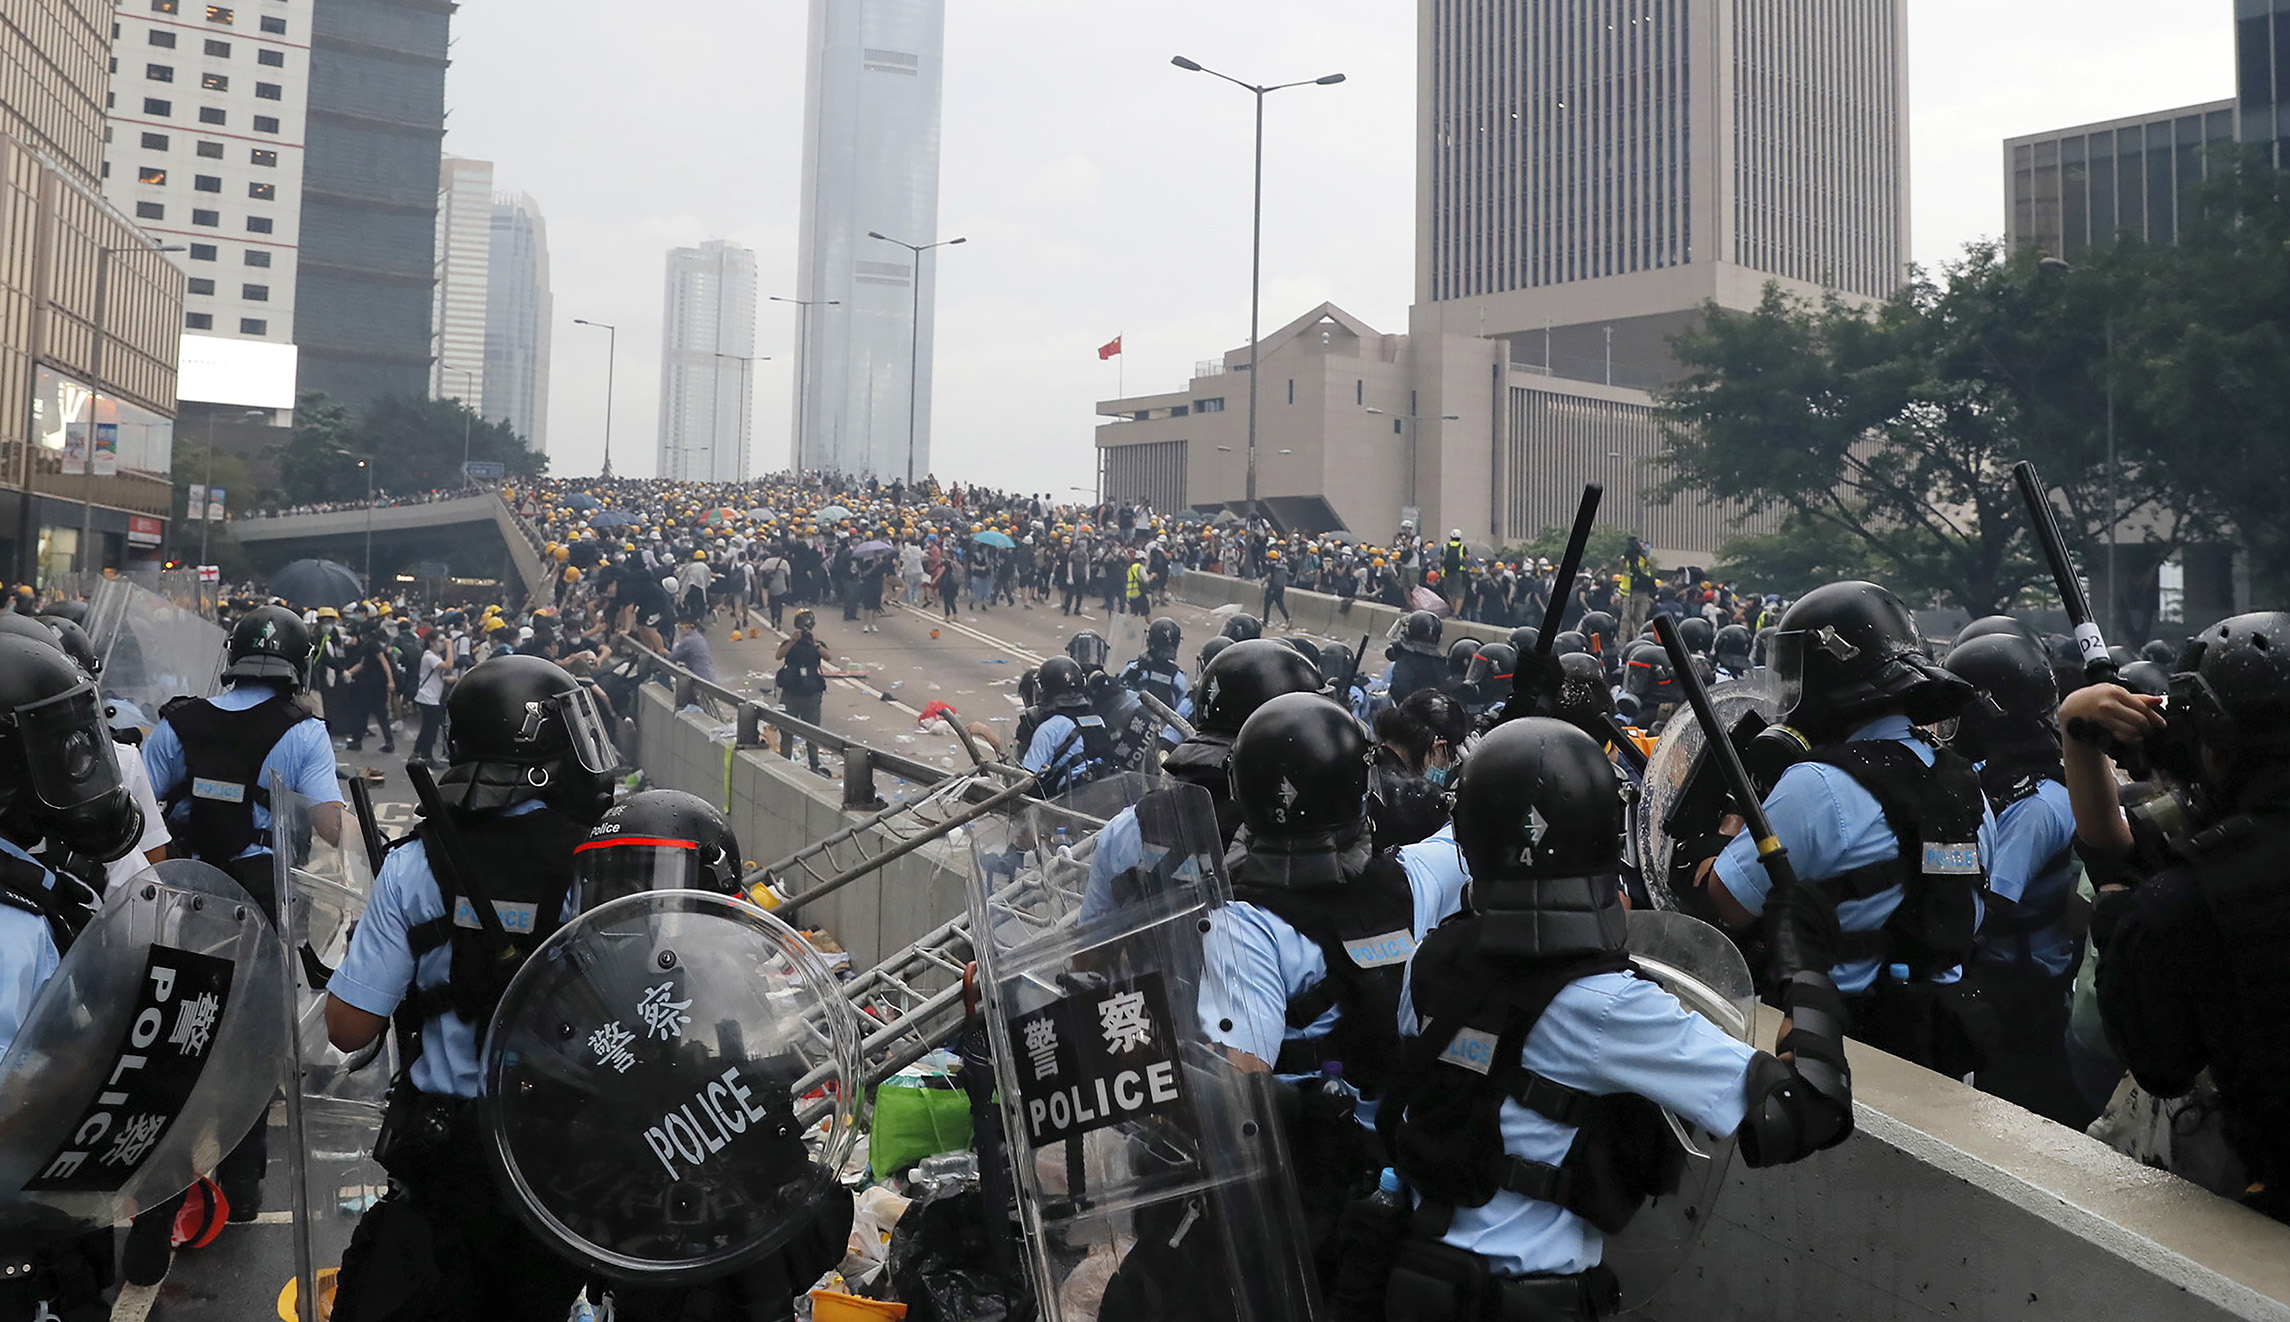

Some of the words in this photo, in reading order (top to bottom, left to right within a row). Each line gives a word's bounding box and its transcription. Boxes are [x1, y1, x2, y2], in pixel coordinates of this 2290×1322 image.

[2080, 635, 2103, 653] D2
[1126, 721, 1158, 769] POLICE
[1275, 808, 1286, 824] 3
[1350, 937, 1413, 962] POLICE
[588, 981, 693, 1074] 警察
[1023, 991, 1151, 1081] 警察
[1450, 1036, 1491, 1064] LICE
[41, 965, 176, 1179] POLICE
[1029, 1060, 1178, 1137] POLICE
[642, 1066, 767, 1181] POLICE
